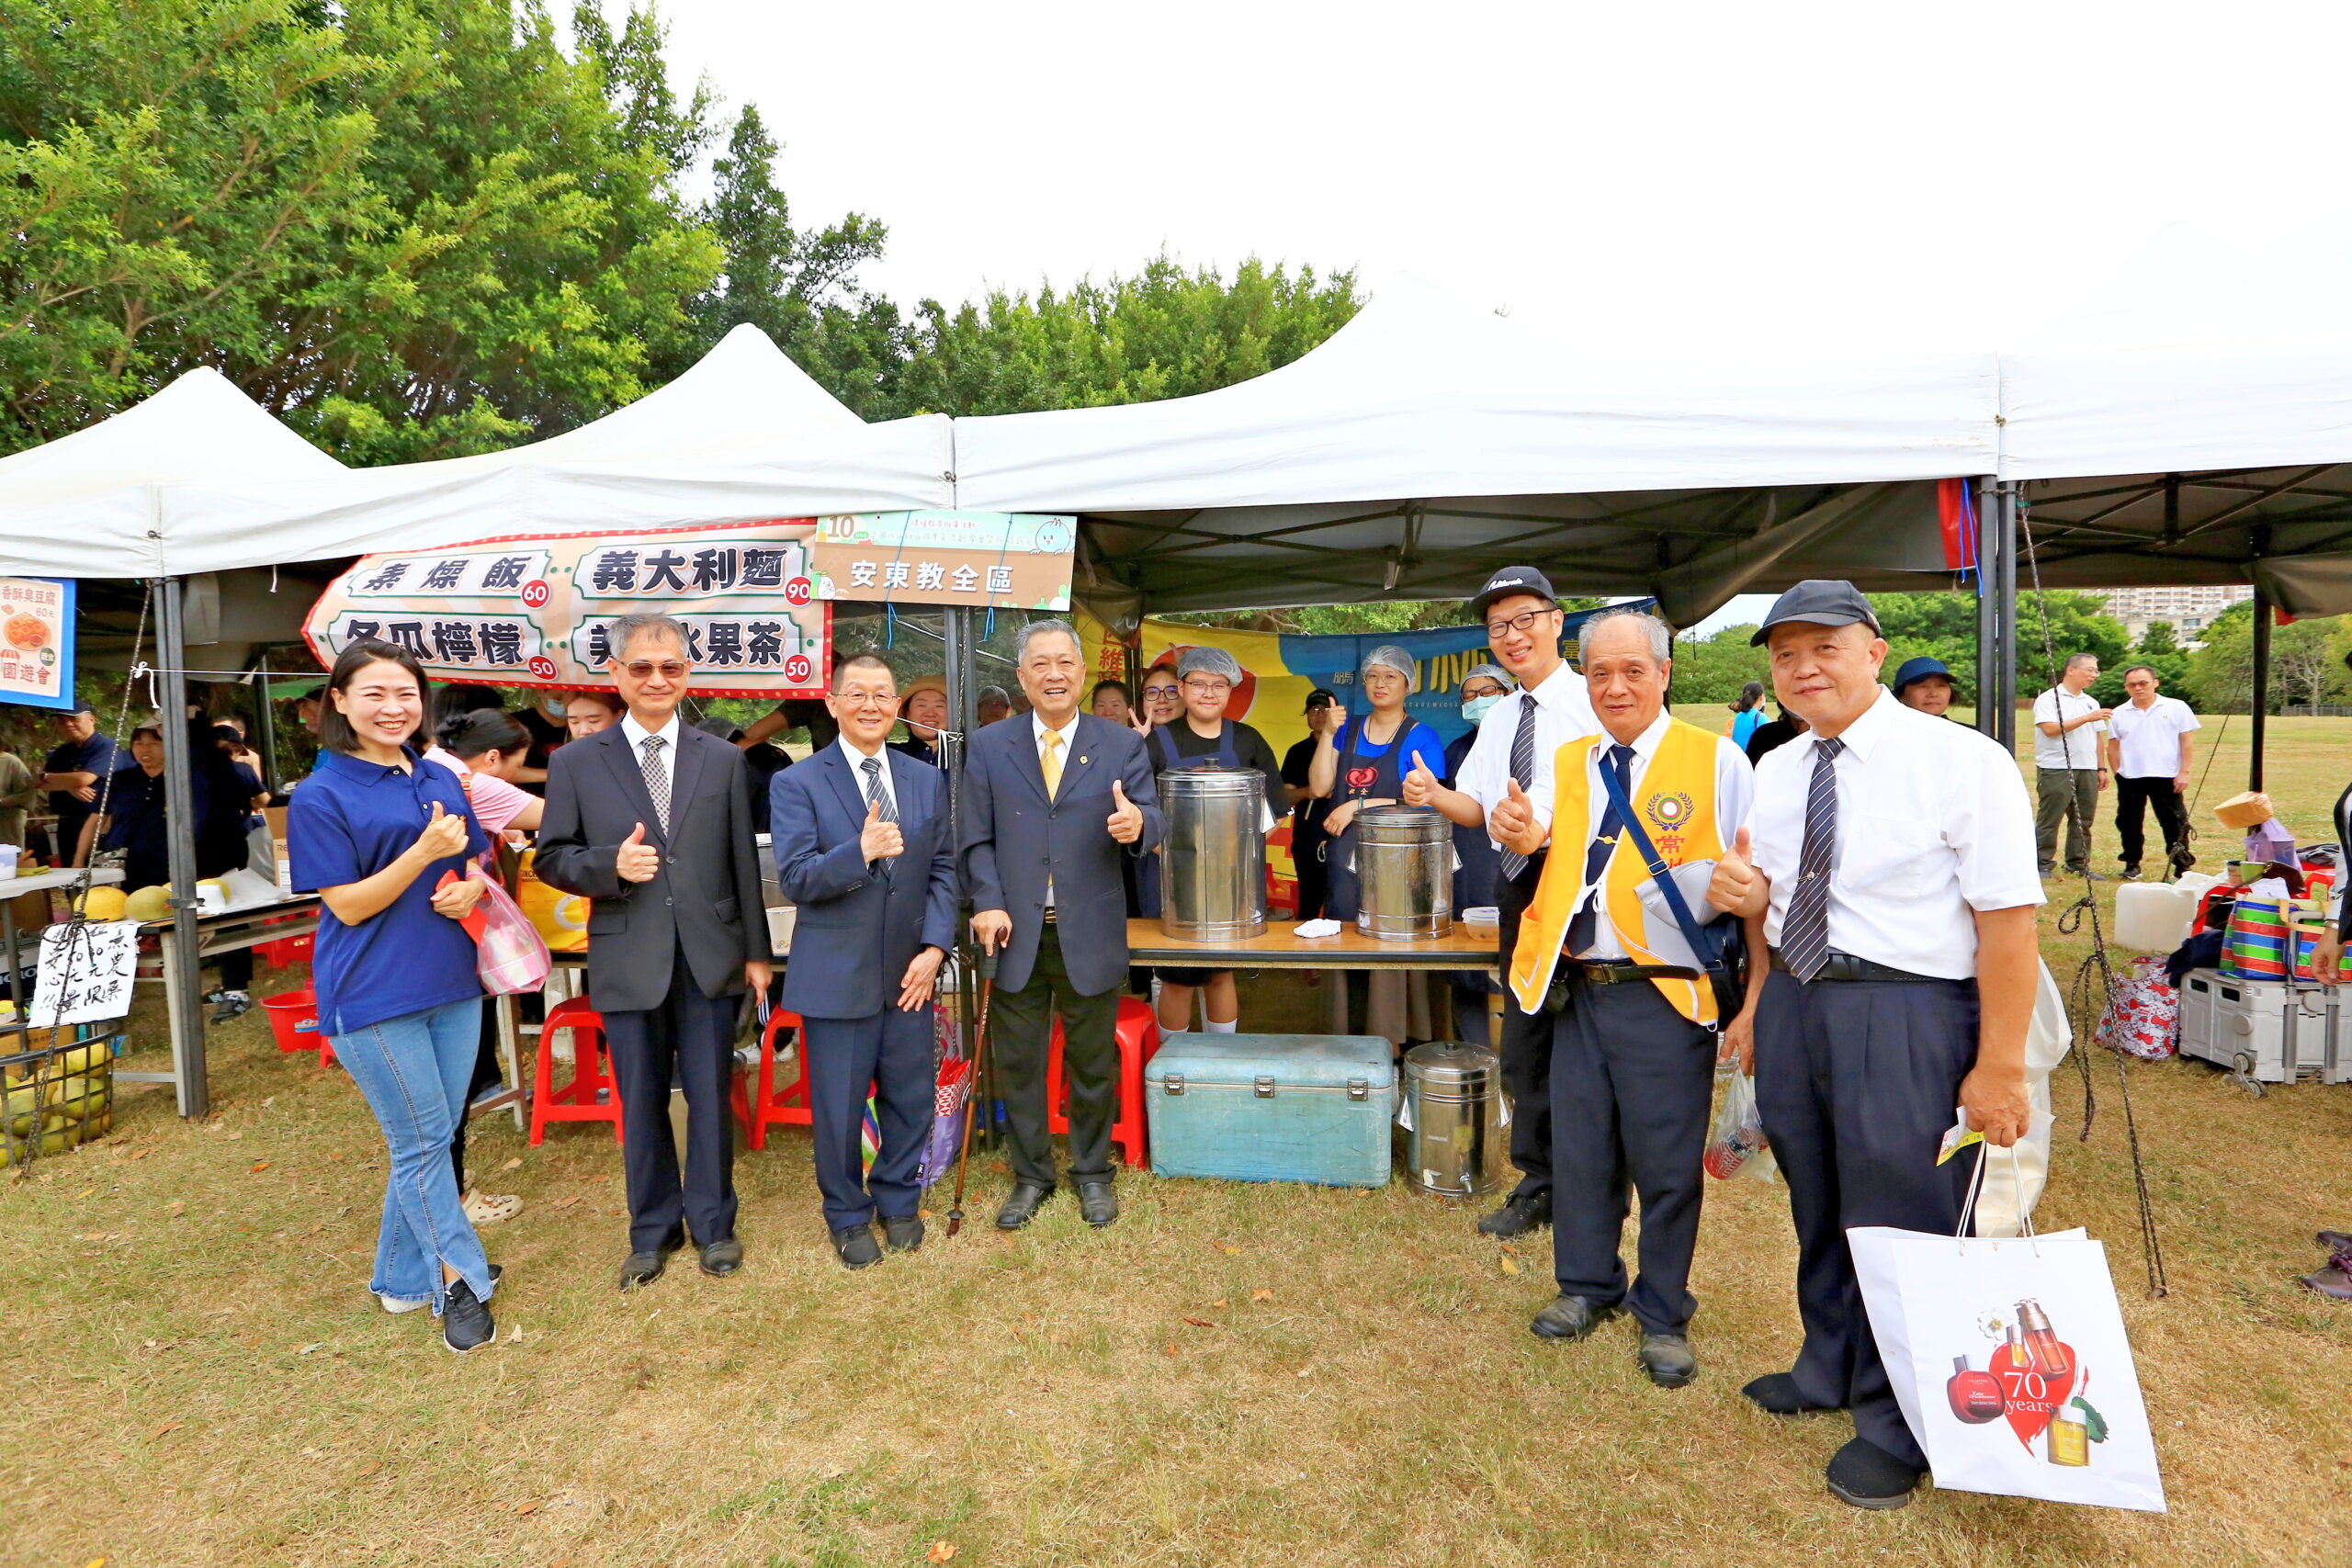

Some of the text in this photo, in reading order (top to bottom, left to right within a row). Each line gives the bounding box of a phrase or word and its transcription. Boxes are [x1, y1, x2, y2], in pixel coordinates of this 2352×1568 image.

[827, 515, 854, 538] 10
[363, 557, 531, 591] 素燥飯
[850, 559, 1013, 593] 安東教全區
[524, 586, 547, 602] 60
[787, 583, 808, 599] 90
[345, 619, 525, 665] 冬瓜檸檬
[589, 621, 783, 665] 美果茶
[3, 662, 51, 685] 園遊會
[531, 660, 554, 675] 50
[786, 660, 808, 677] 50
[2004, 1371, 2047, 1400] 70
[2006, 1398, 2054, 1415] years
